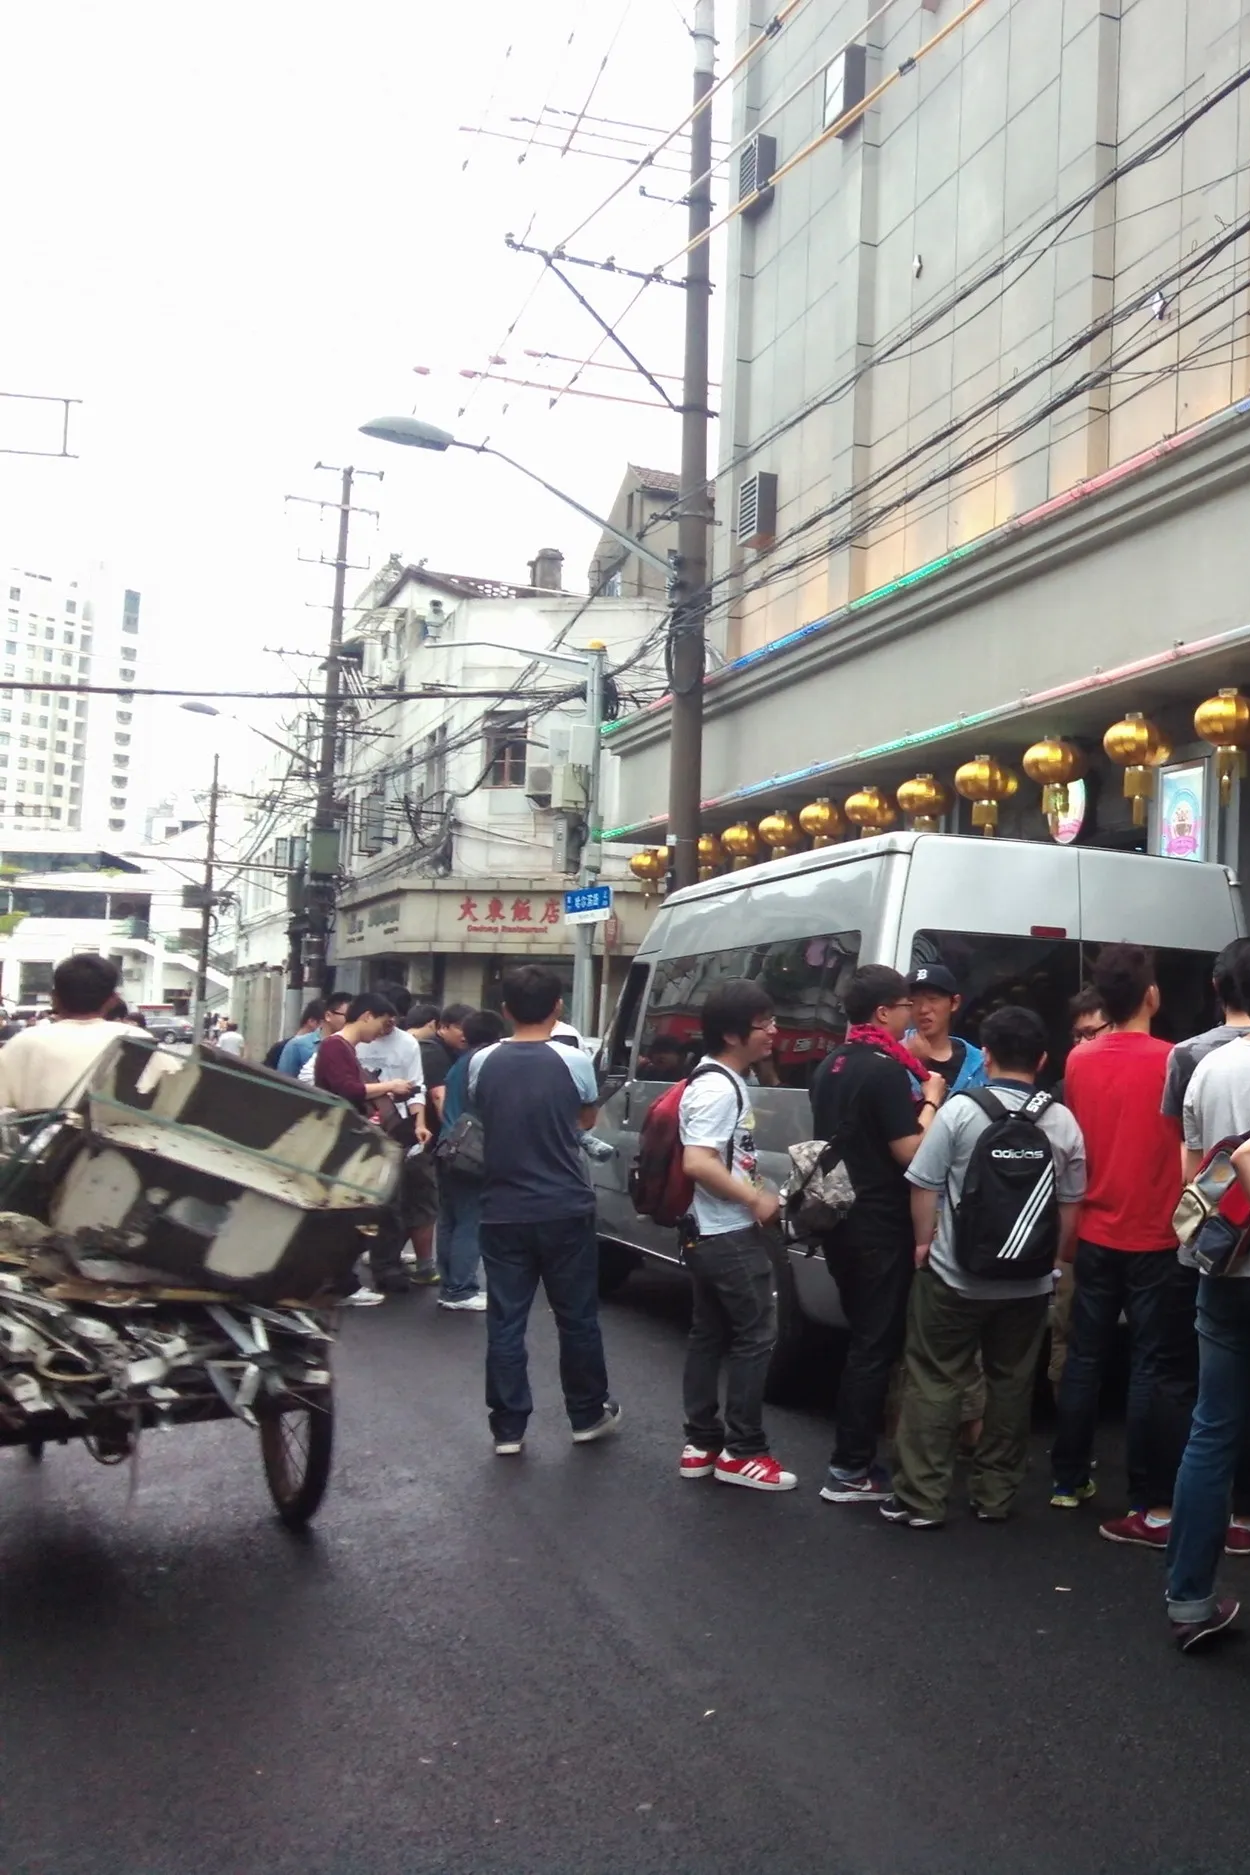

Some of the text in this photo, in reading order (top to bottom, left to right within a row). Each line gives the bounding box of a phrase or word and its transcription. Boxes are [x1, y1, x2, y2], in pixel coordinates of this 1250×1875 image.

[457, 896, 560, 924] 大東飯店
[991, 1148, 1044, 1159] adidas
